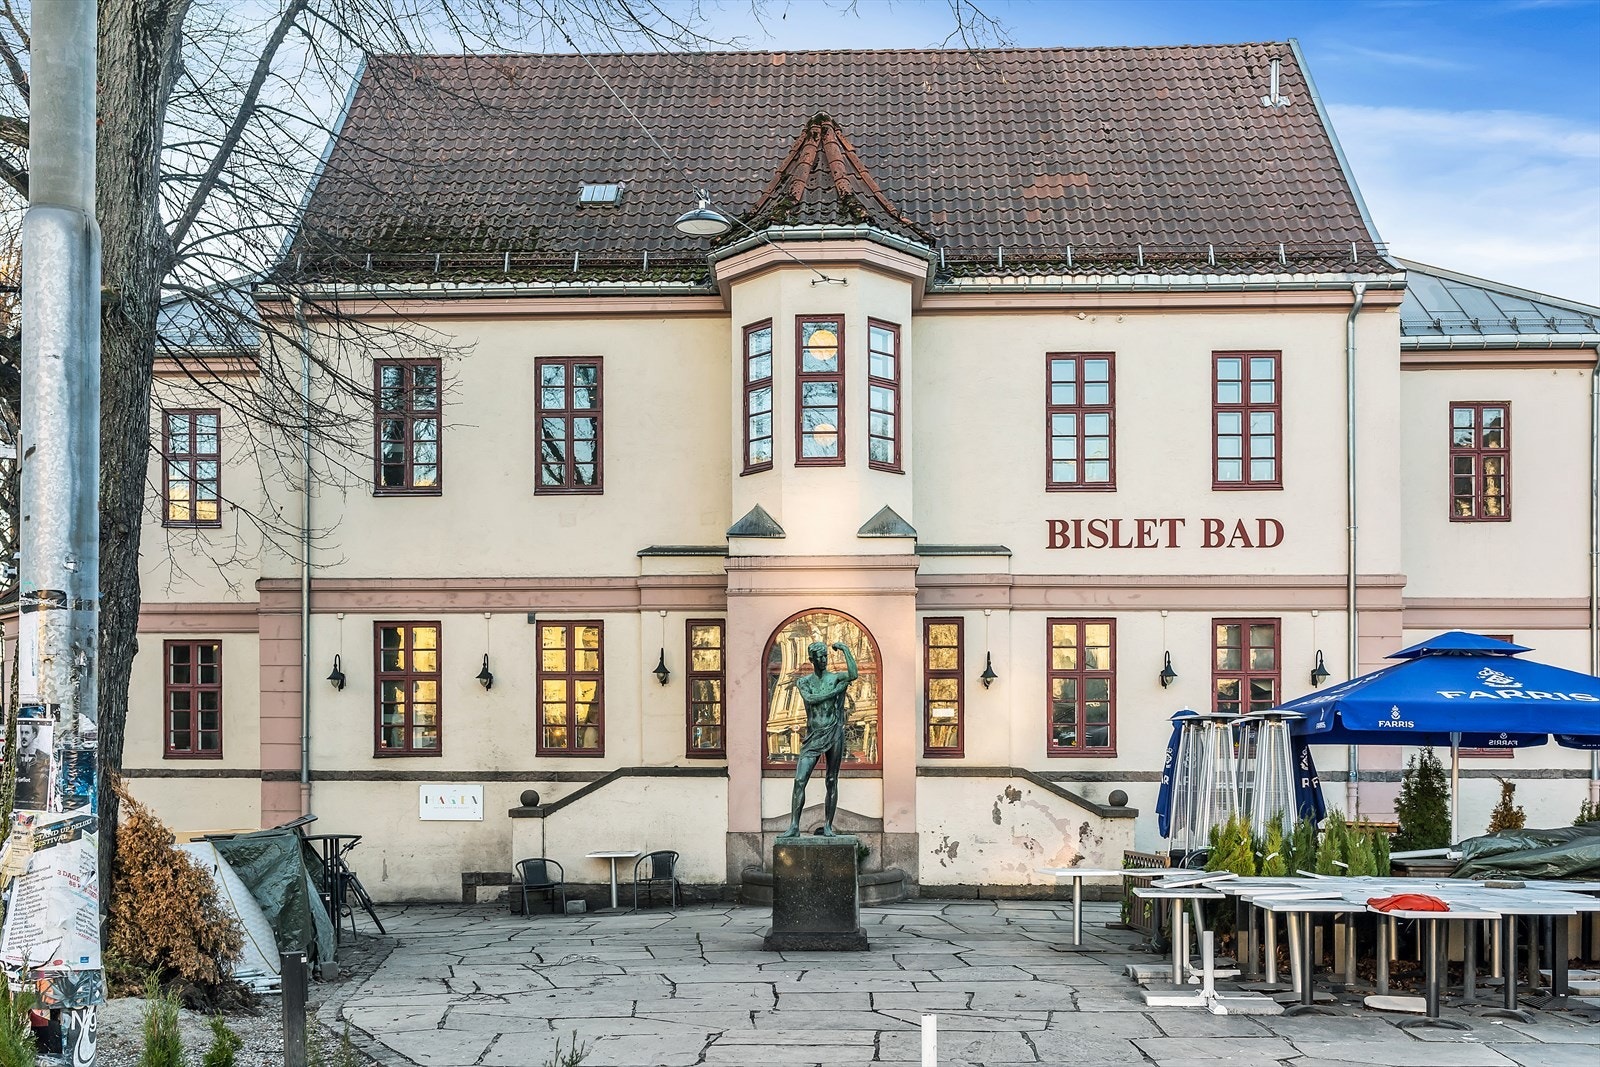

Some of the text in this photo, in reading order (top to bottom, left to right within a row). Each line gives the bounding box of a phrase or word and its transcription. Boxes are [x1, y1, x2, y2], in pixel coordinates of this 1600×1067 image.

[1045, 518, 1285, 549] BISLET BAD
[1436, 689, 1600, 702] FARRIS
[1378, 720, 1415, 728] FARRIS
